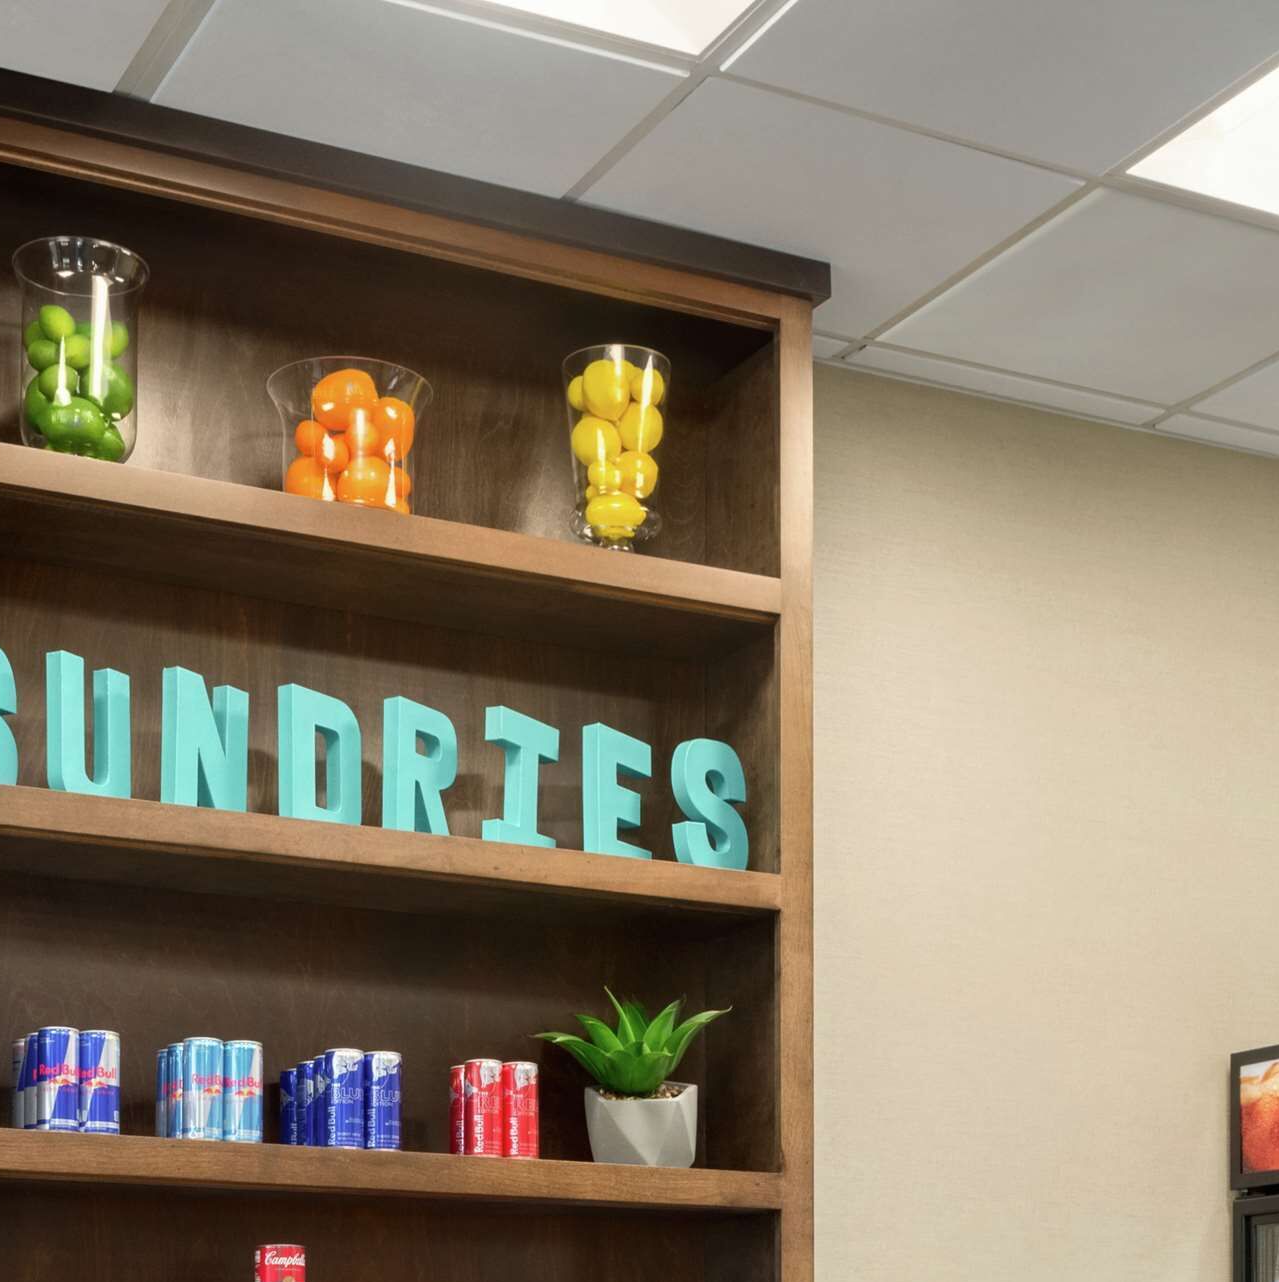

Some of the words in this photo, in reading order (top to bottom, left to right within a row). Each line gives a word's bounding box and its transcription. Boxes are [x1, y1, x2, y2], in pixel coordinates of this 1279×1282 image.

[39, 1064, 61, 1079] Red
[96, 1064, 117, 1079] Bull
[192, 1073, 215, 1088] Red
[328, 1105, 336, 1128] Bull
[367, 1107, 376, 1130] Bull
[474, 1114, 484, 1135] Bull
[510, 1116, 519, 1136] Bull
[328, 1129, 336, 1146] Red
[367, 1131, 376, 1148] Red
[474, 1136, 484, 1153] Red
[510, 1136, 519, 1155] Red
